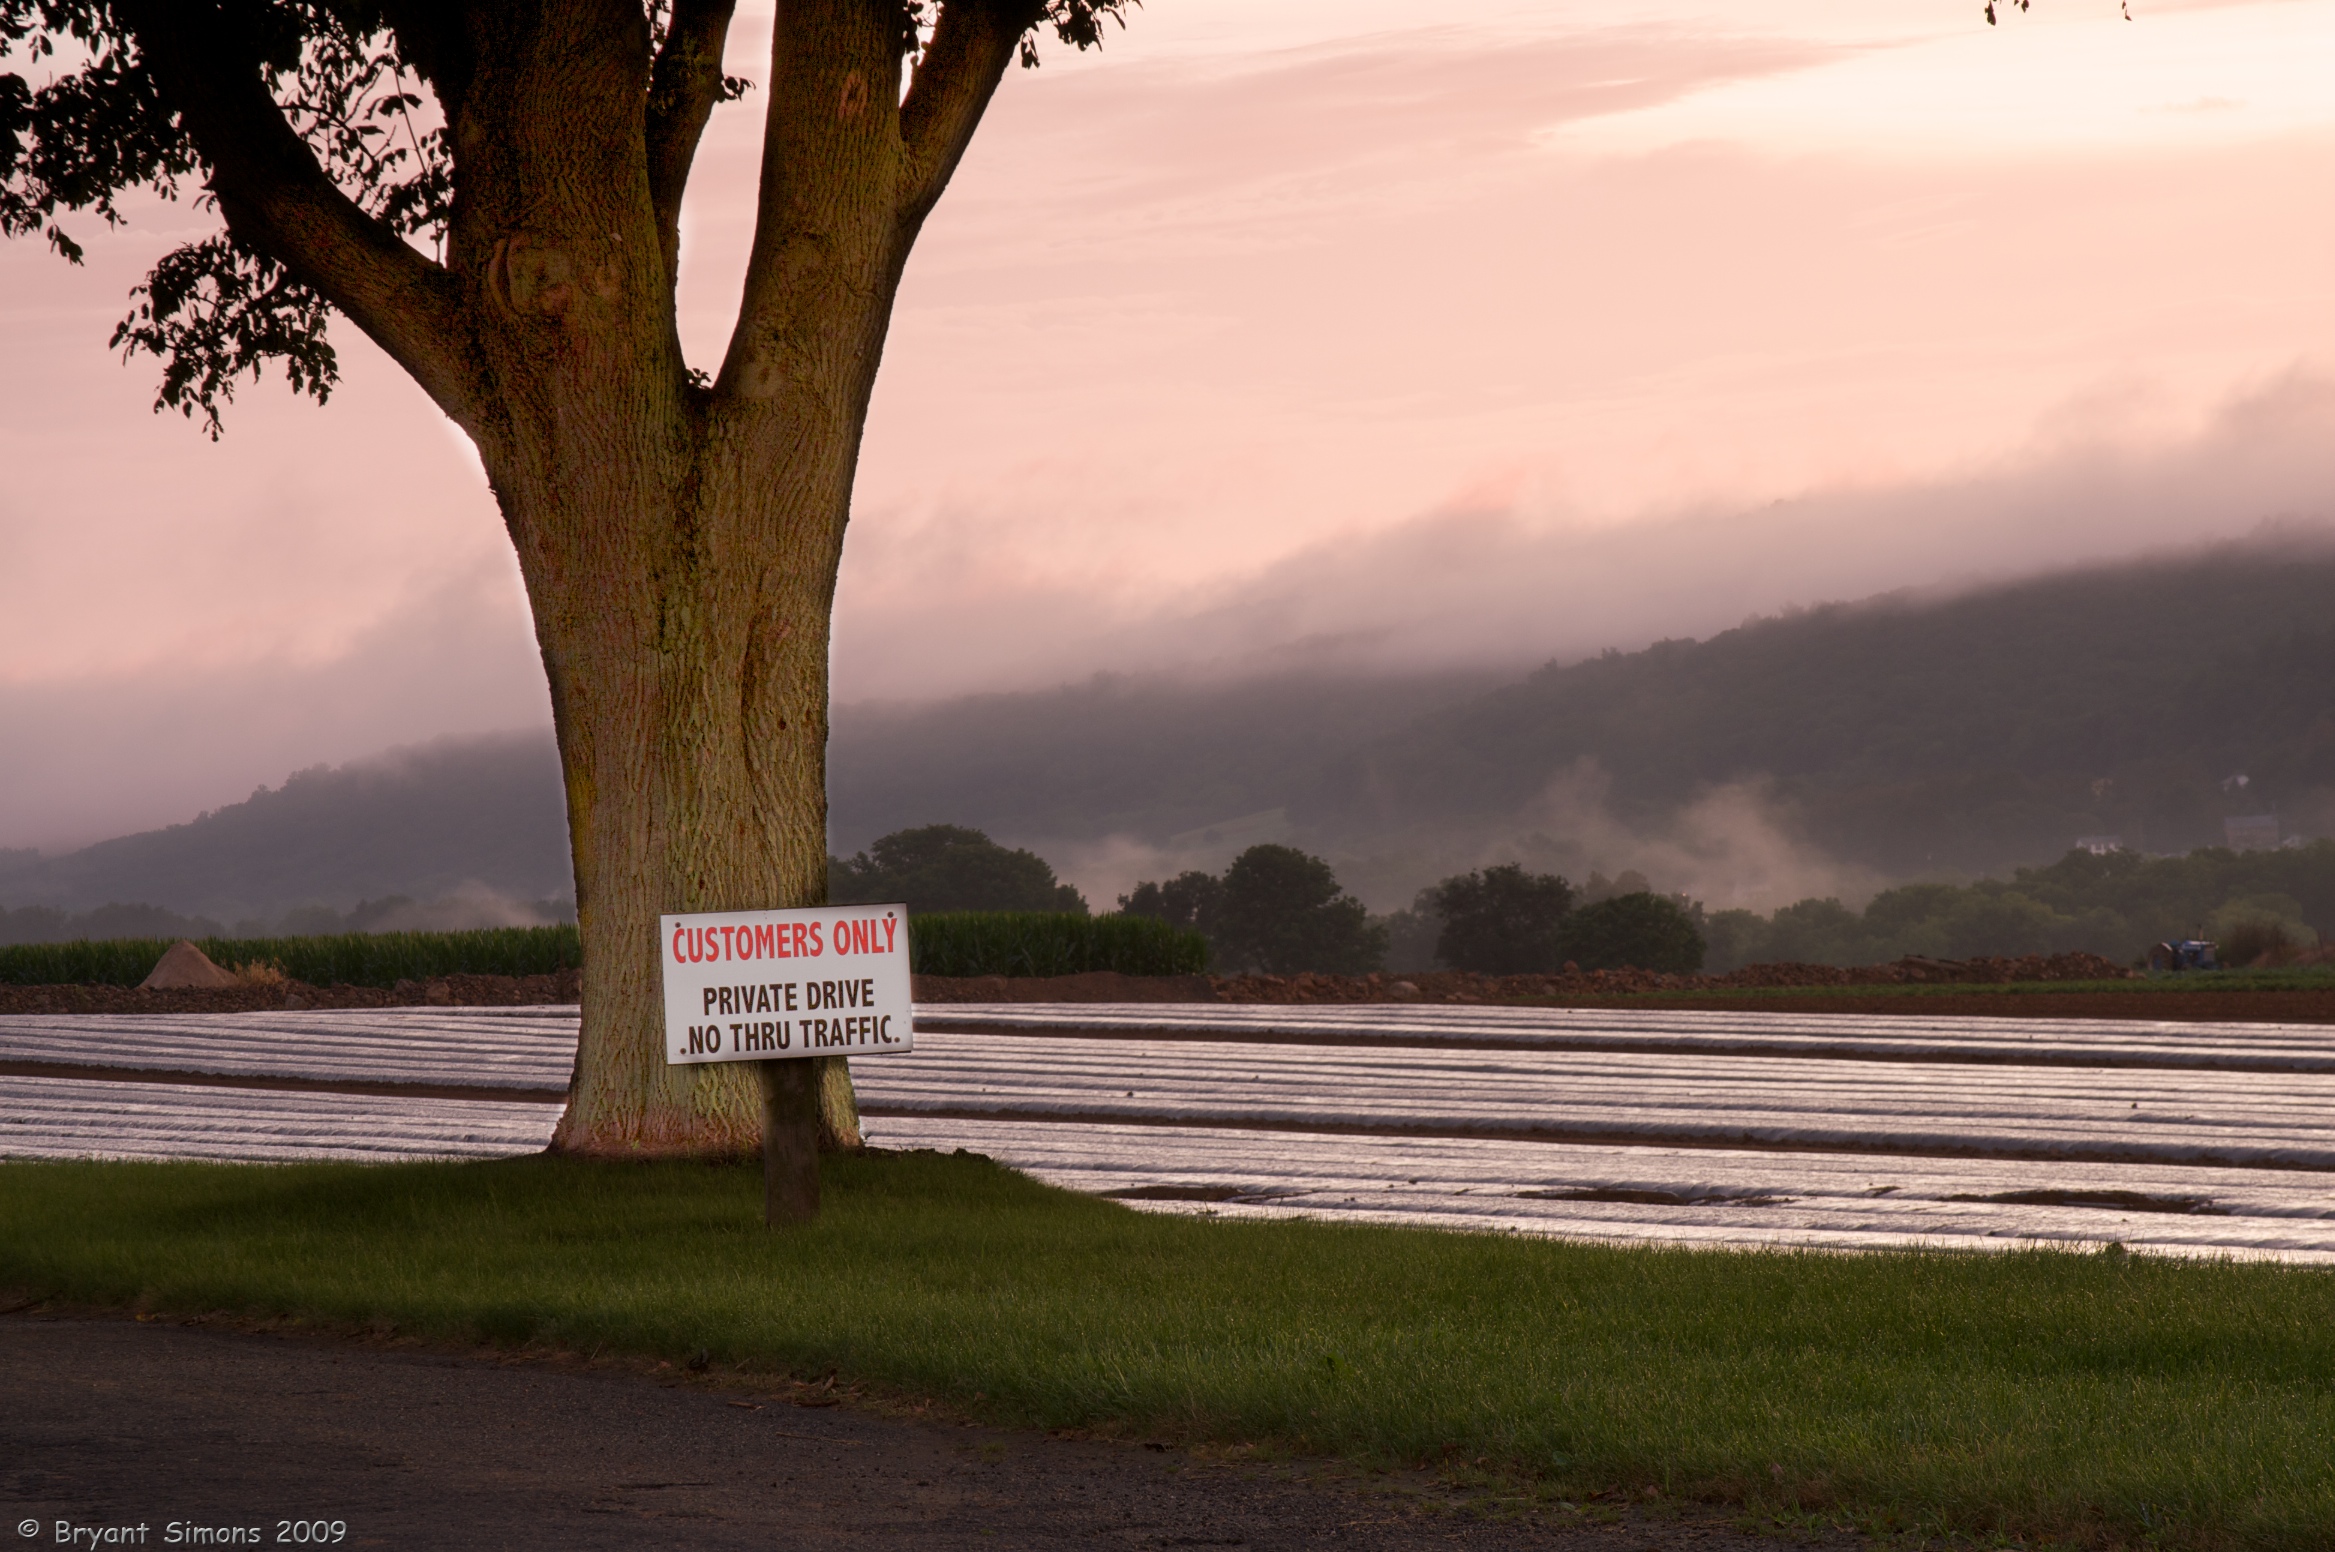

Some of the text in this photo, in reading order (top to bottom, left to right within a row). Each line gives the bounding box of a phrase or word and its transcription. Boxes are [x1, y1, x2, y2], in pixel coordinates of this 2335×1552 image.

[673, 918, 898, 964] CUSTOMERS ONLY
[703, 978, 875, 1016] PRIVATE DRIVE
[688, 1025, 721, 1055] NO
[729, 1020, 790, 1052] THRU
